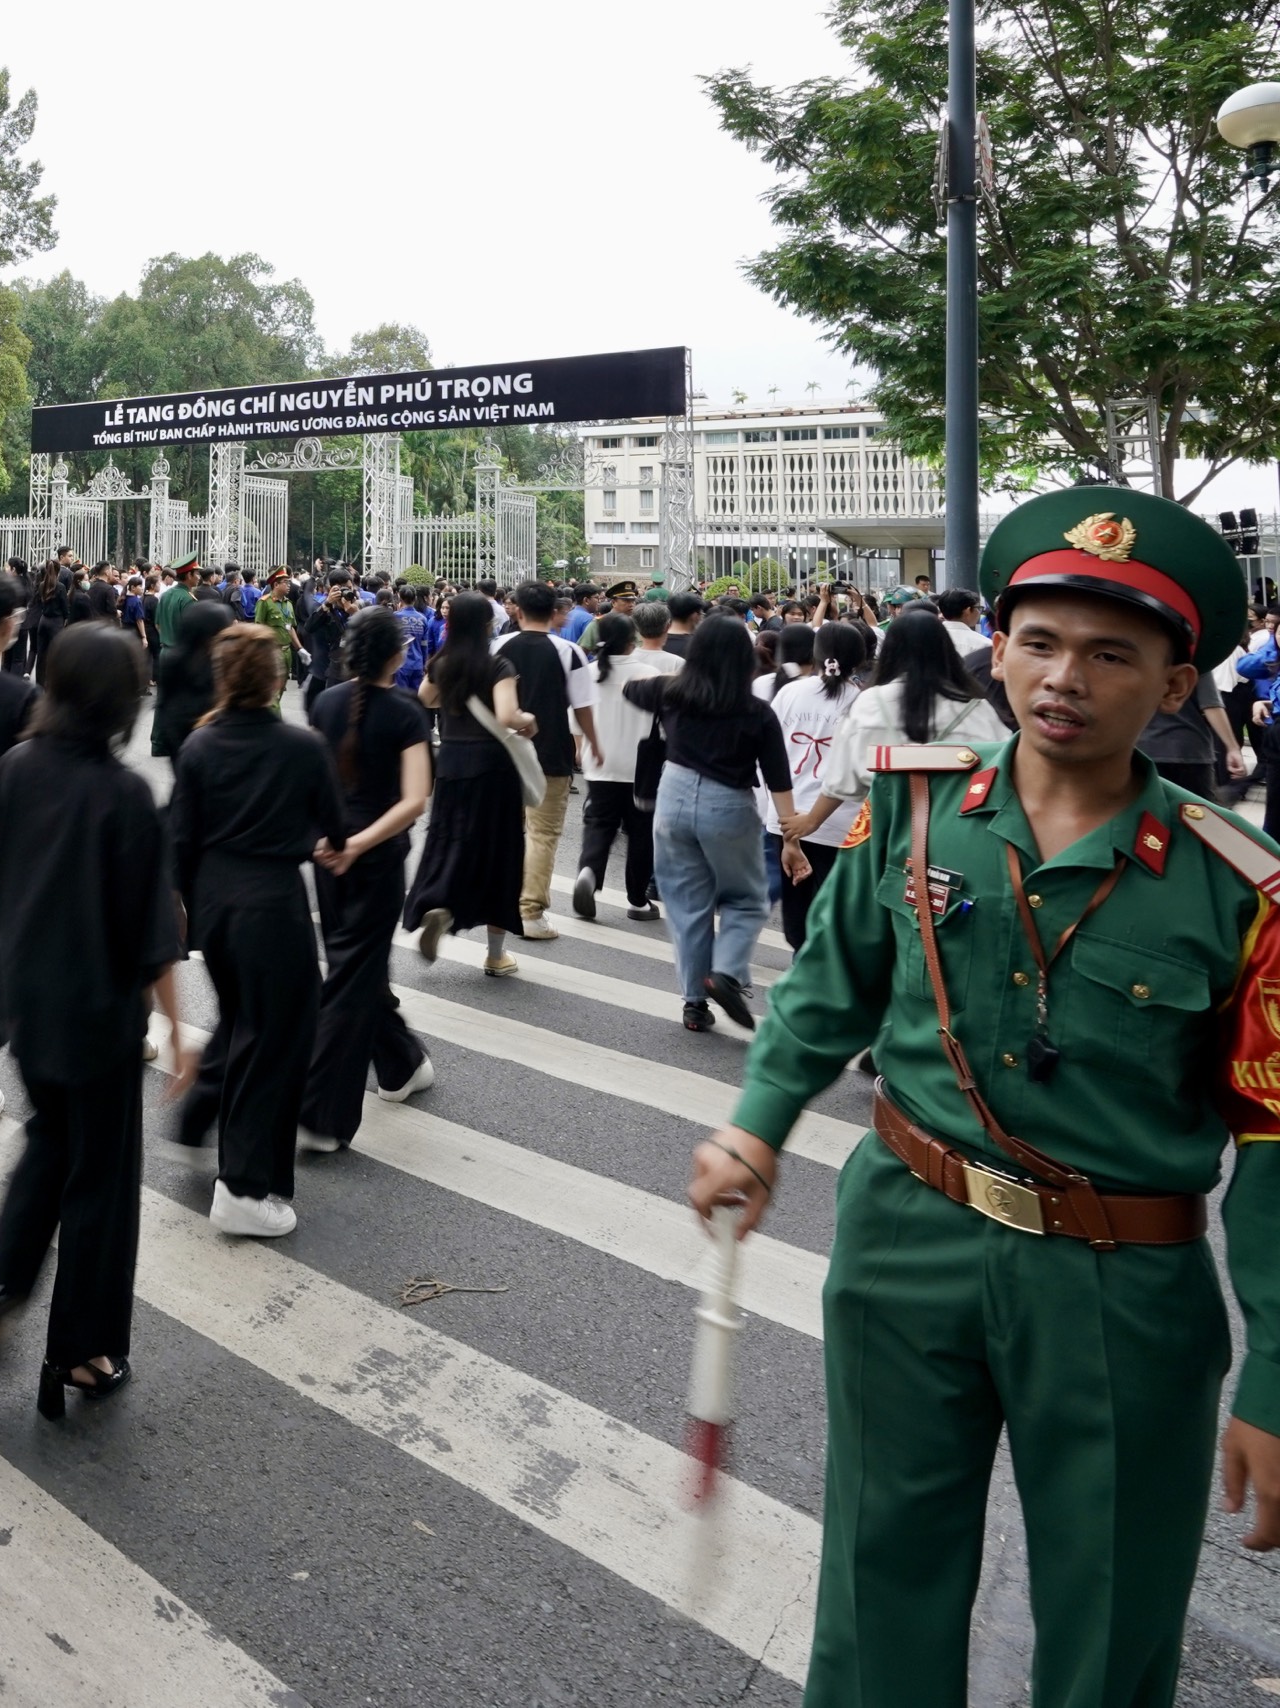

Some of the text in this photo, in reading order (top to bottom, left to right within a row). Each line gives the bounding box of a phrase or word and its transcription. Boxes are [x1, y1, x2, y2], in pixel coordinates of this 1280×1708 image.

[104, 372, 533, 426] LỄ TANG ĐỒNG CHÍ NGUYỄN PHÚ TRỌNG
[93, 402, 555, 445] TỔNG BÍ THƯ BAN CHẤP HÀNH TRUNG ƯƠNG ĐẢNG CỘNG SẢN VIỆT NAM
